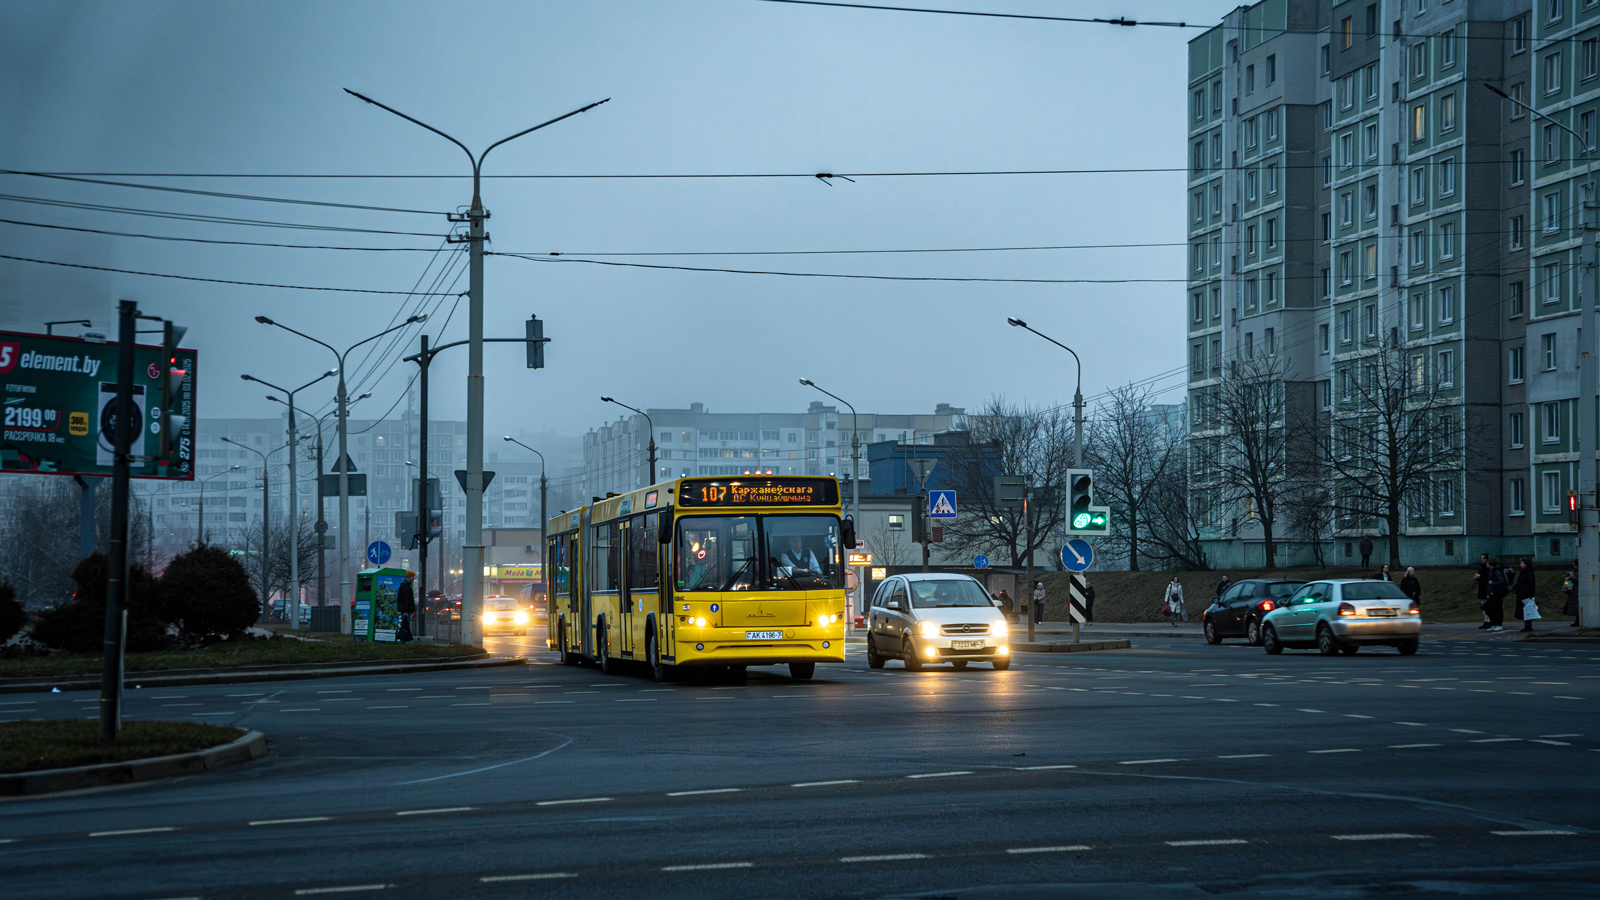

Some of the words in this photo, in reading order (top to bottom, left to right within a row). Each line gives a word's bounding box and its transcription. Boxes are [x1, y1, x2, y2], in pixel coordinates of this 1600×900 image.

[0, 346, 13, 367] 5
[20, 350, 101, 377] element.by
[3, 430, 46, 442] РАССРОЧКА
[47, 433, 56, 443] 18
[180, 437, 190, 460] 275
[701, 486, 727, 502] 107
[731, 484, 813, 496] Каржанеўскага
[732, 493, 747, 503] ДС
